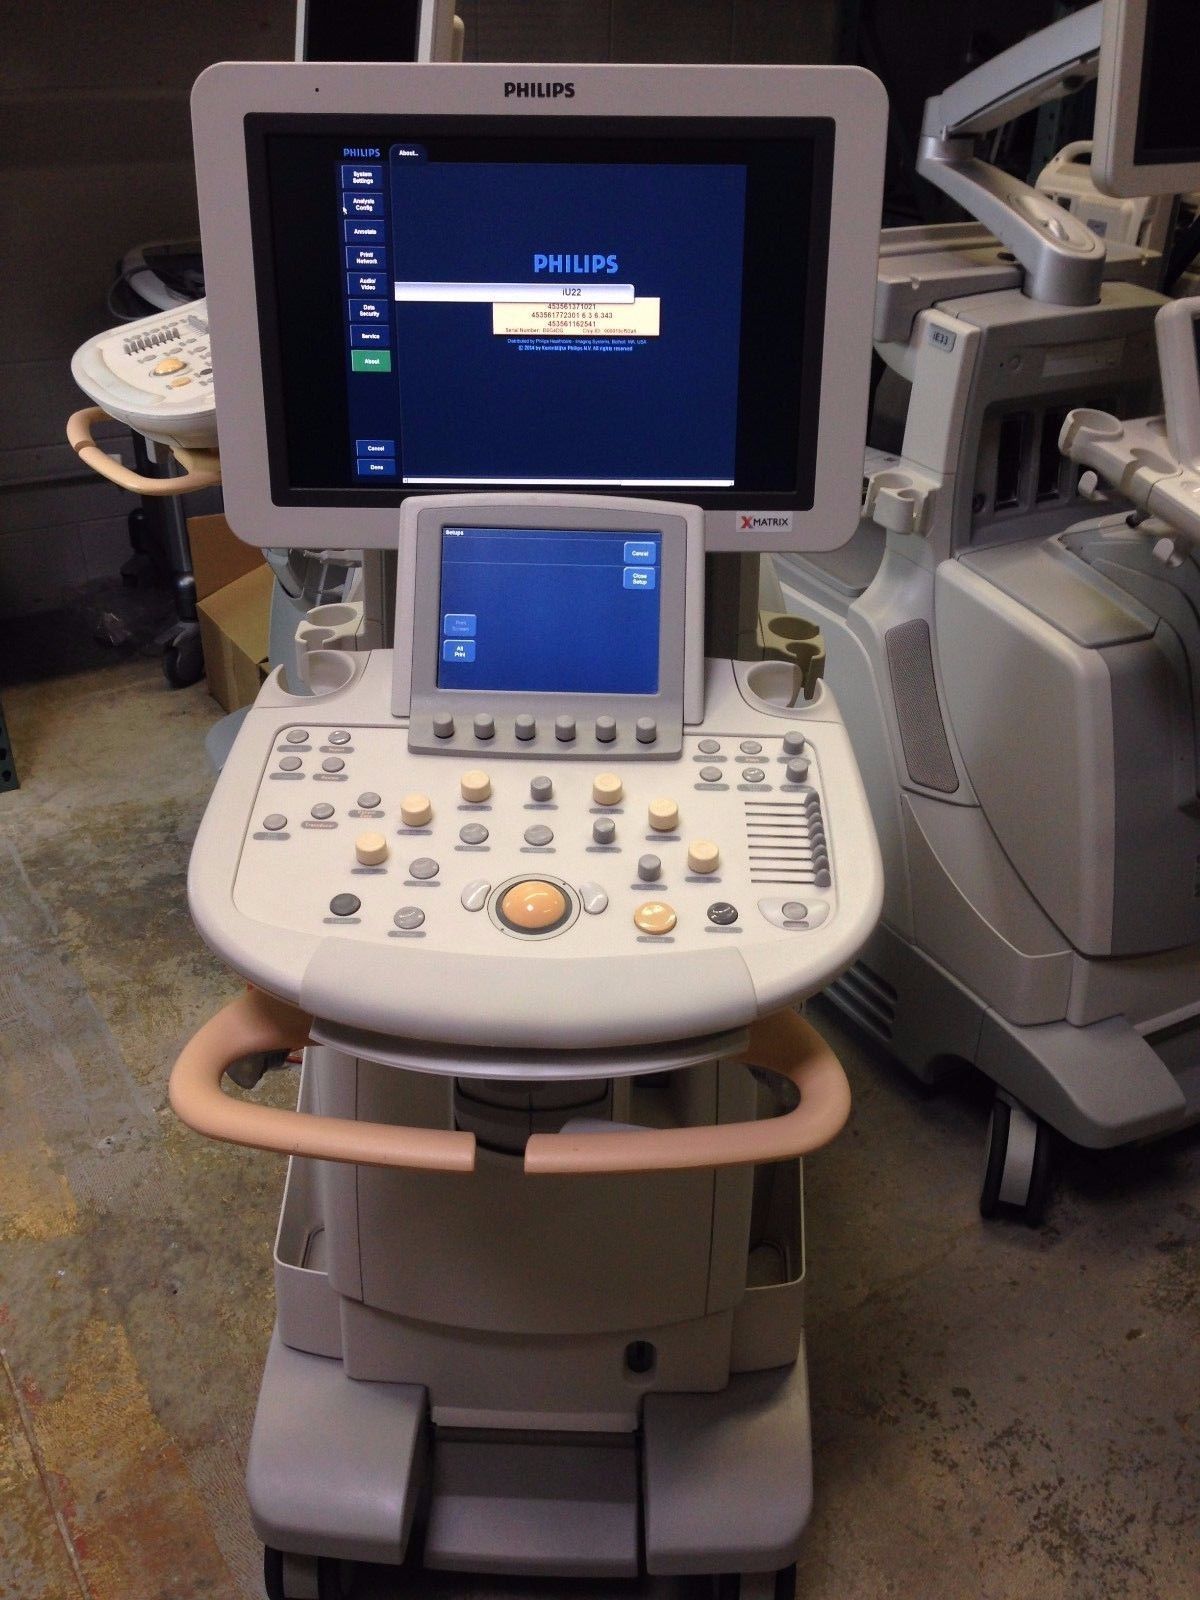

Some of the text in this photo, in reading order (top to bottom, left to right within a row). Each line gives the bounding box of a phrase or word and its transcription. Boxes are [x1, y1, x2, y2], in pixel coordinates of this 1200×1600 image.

[504, 82, 575, 98] PHILIPS
[343, 148, 381, 157] PHILIPS
[534, 254, 619, 274] PHILIPS
[562, 288, 582, 297] iU22
[359, 310, 380, 318] Security
